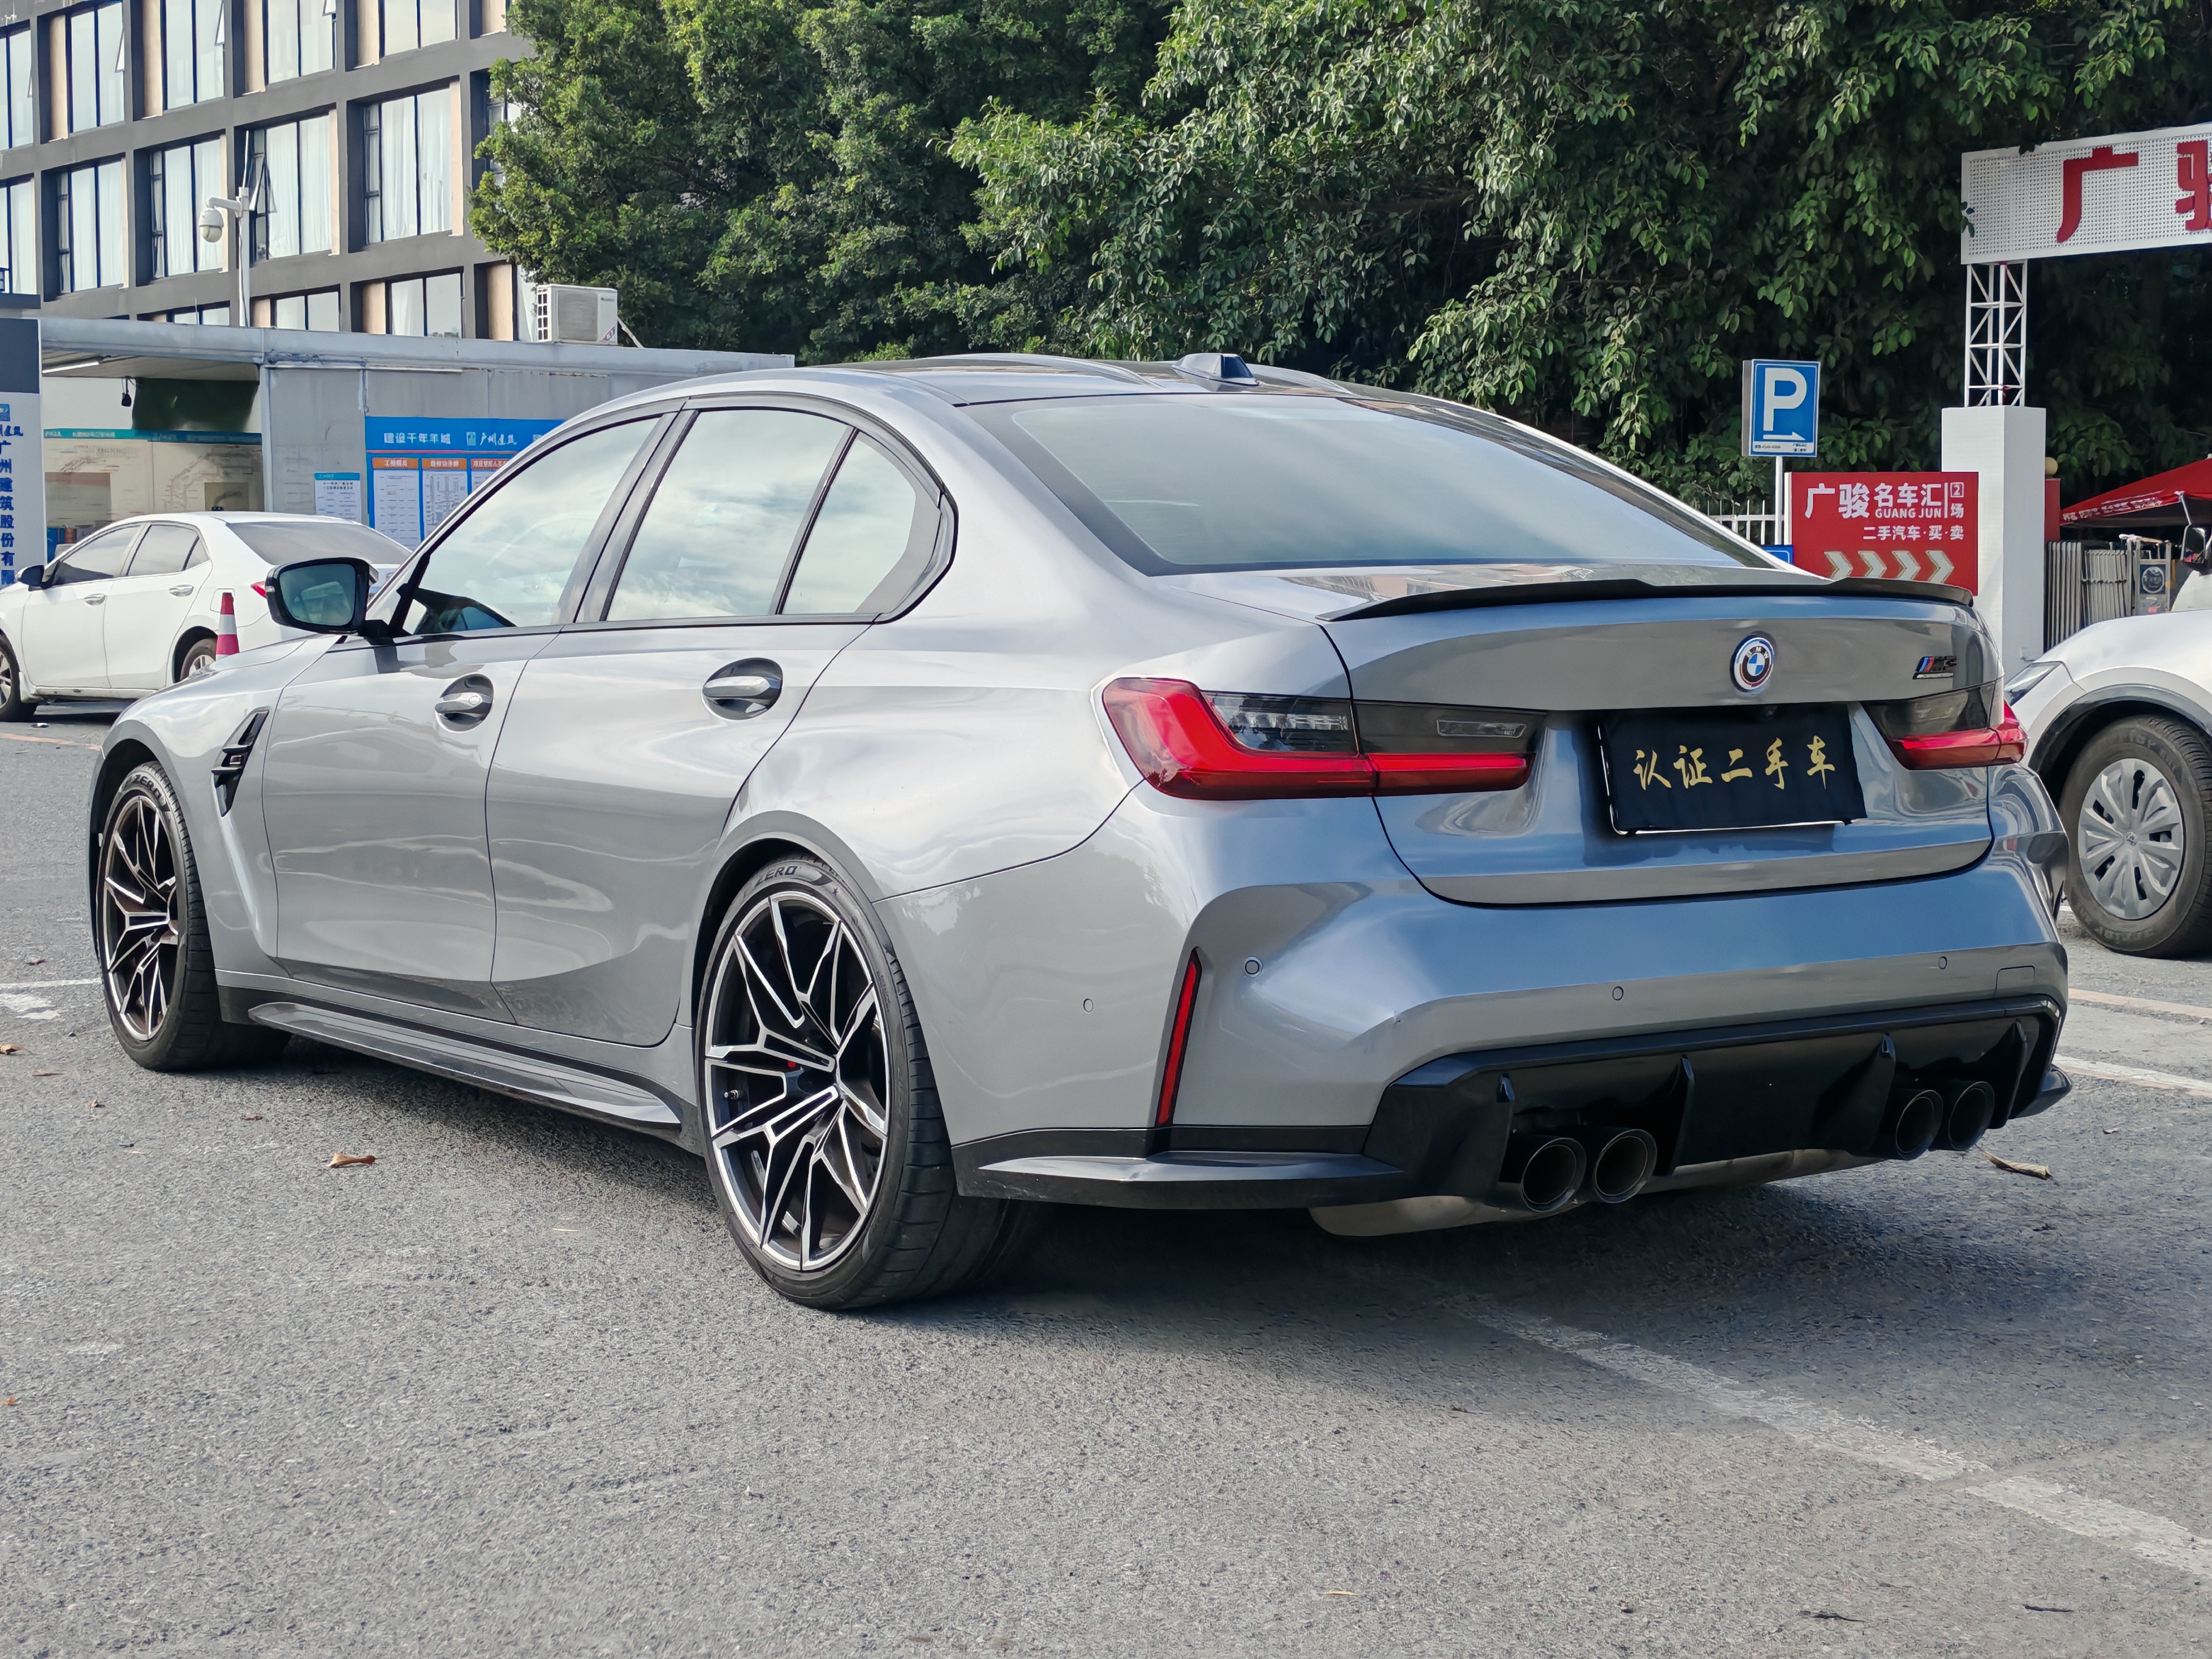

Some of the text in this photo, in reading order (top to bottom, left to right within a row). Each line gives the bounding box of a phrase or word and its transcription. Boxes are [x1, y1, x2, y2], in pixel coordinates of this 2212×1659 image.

[1763, 367, 1808, 431] P
[1805, 482, 1942, 519] 广骏名车汇
[1875, 508, 1941, 518] GUANG JUN
[1746, 646, 1770, 659] BMW
[1633, 735, 1836, 791] 认证二手车
